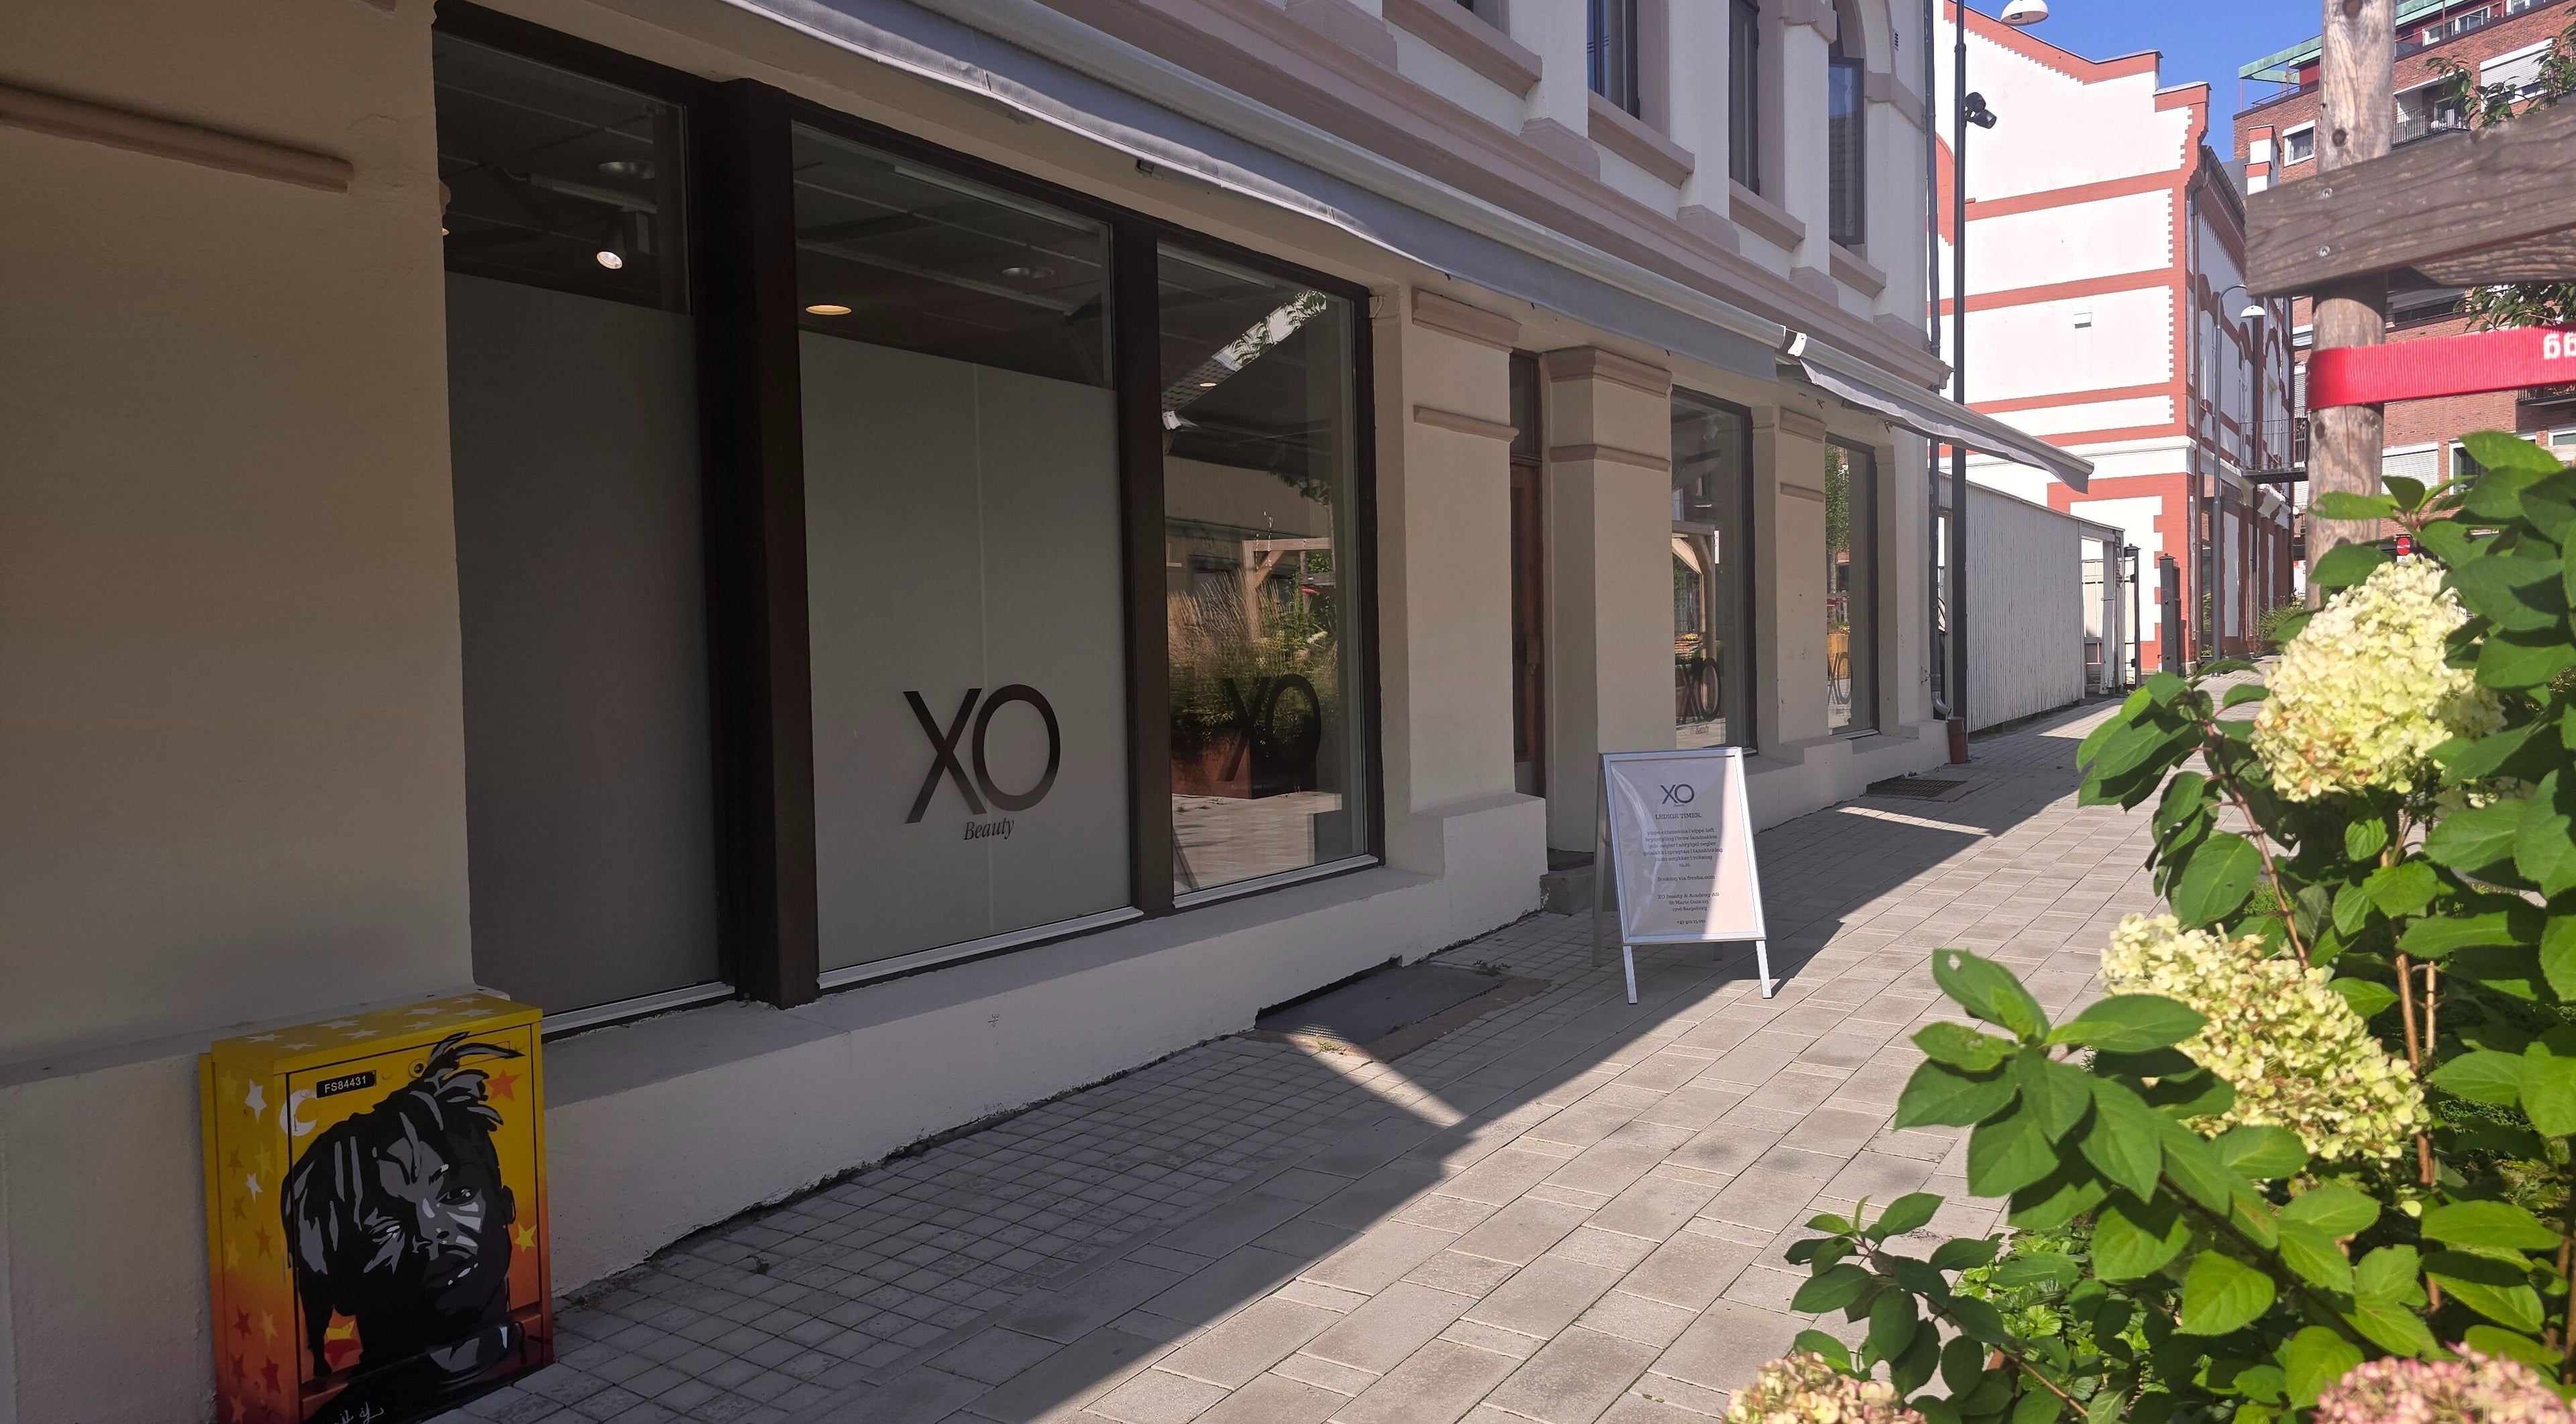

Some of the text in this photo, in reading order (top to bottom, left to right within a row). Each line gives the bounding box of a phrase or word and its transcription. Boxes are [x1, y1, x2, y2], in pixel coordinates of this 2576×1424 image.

[903, 683, 1061, 824] XO
[1660, 783, 1695, 804] XO
[963, 817, 1014, 840] Beauty
[324, 1075, 366, 1094] FS84431
